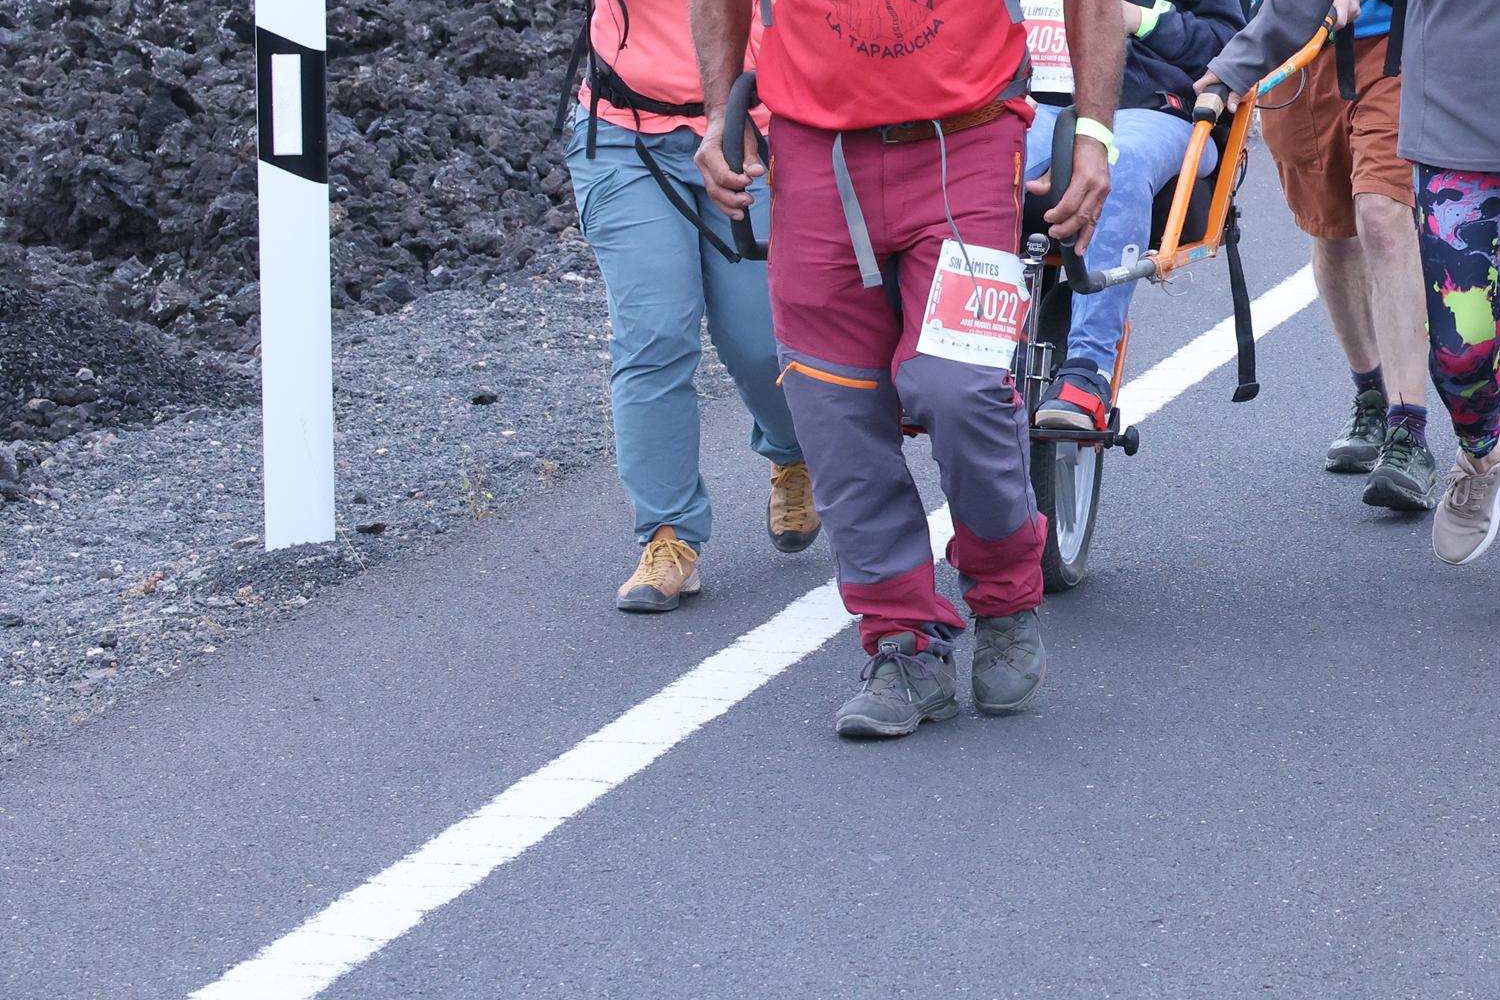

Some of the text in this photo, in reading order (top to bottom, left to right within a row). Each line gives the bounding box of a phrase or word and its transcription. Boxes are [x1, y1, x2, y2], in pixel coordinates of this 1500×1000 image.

[1027, 4, 1060, 18] LÍMITES
[825, 11, 945, 60] LA TAPARUCHA
[1026, 25, 1069, 54] 405
[949, 256, 1000, 277] SIN LÍMITES
[964, 285, 1018, 325] 4022
